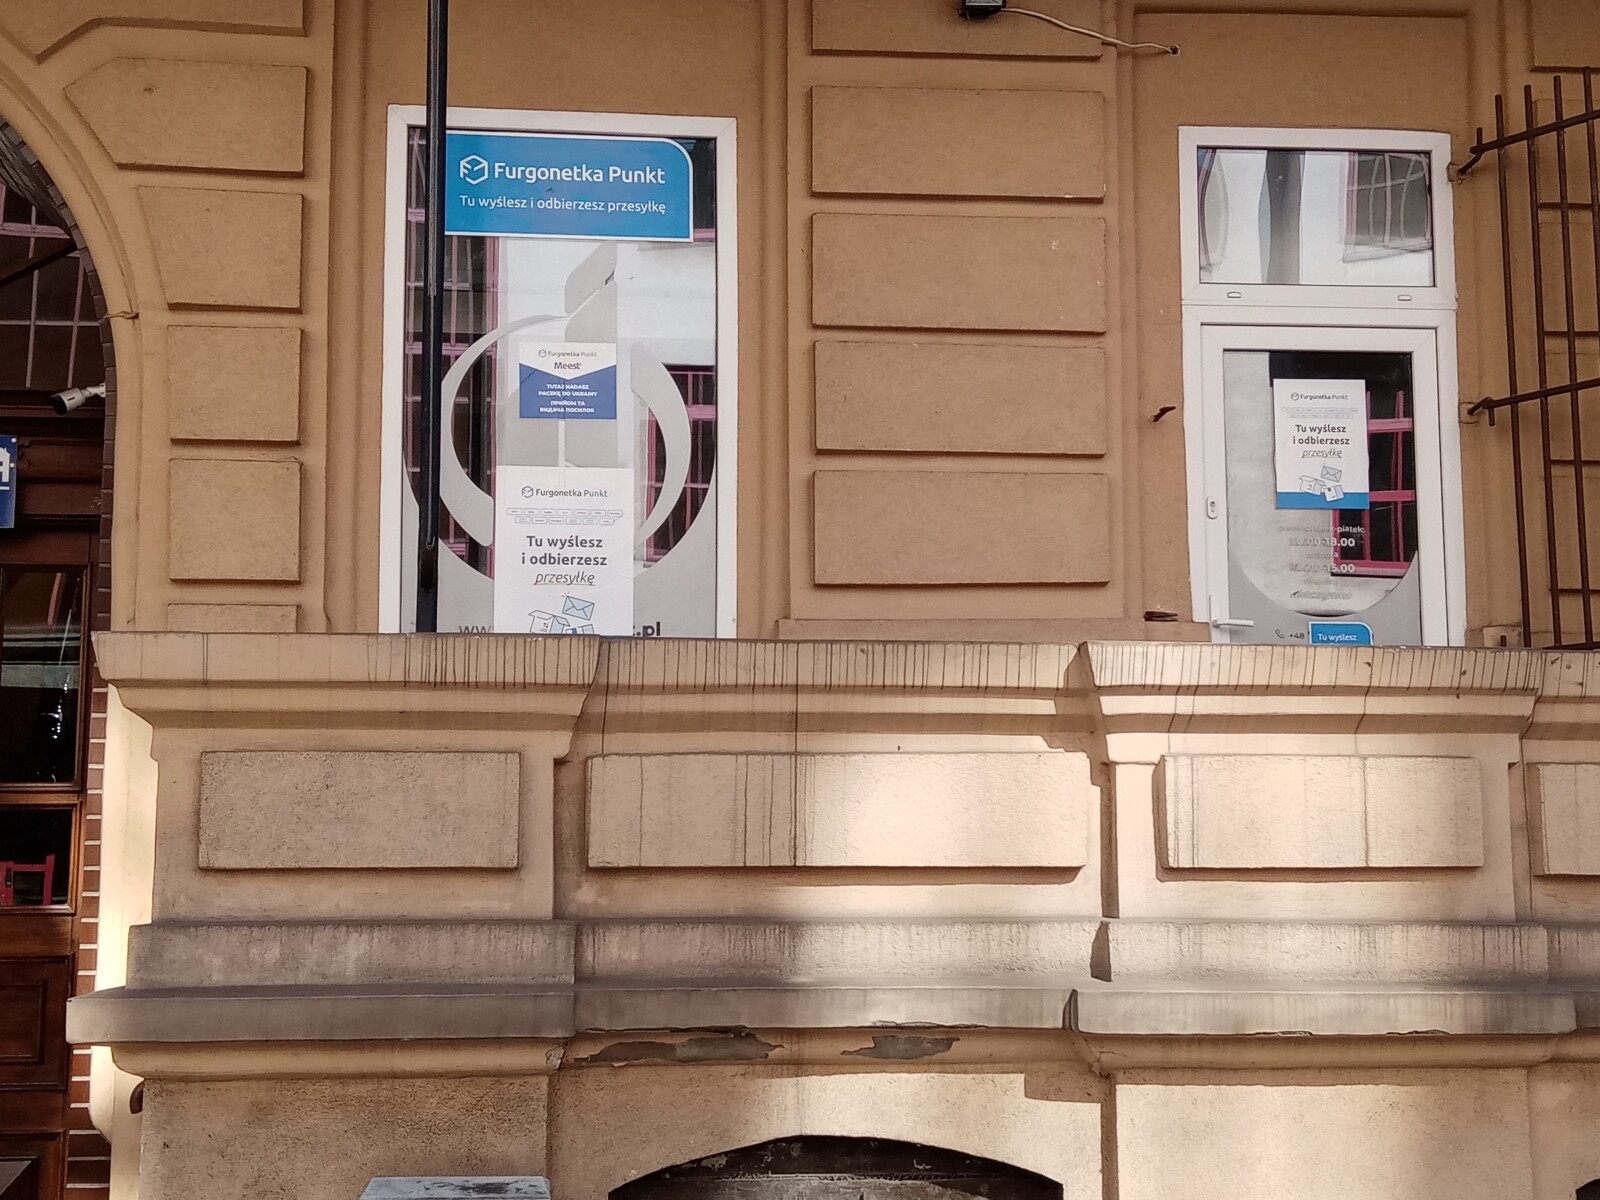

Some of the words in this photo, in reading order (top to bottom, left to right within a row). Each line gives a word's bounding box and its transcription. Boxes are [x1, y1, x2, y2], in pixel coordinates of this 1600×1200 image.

[494, 162, 604, 184] Furgonetka
[608, 165, 666, 184] Punkt
[460, 194, 475, 207] Tu
[478, 195, 527, 210] wyślesz
[530, 196, 534, 209] i
[537, 197, 605, 211] odbierzesz
[608, 200, 667, 215] przesyłkę
[554, 361, 581, 370] Meest
[1299, 393, 1331, 401] Furgonetka
[1332, 393, 1348, 401] Punkt
[1295, 424, 1307, 433] Tu
[1309, 424, 1347, 435] wyślesz
[1298, 435, 1351, 445] odbierzesz
[1301, 447, 1343, 459] przesyłkę
[535, 488, 582, 498] Furgonetka
[583, 489, 608, 498] Punkt
[526, 535, 543, 547] Tu
[547, 534, 604, 550] wyślesz
[521, 552, 526, 565] i
[530, 553, 608, 566] odbierzesz
[533, 570, 596, 586] przesyłkę
[1317, 633, 1328, 641] Tu
[1328, 632, 1357, 642] wyślesz
